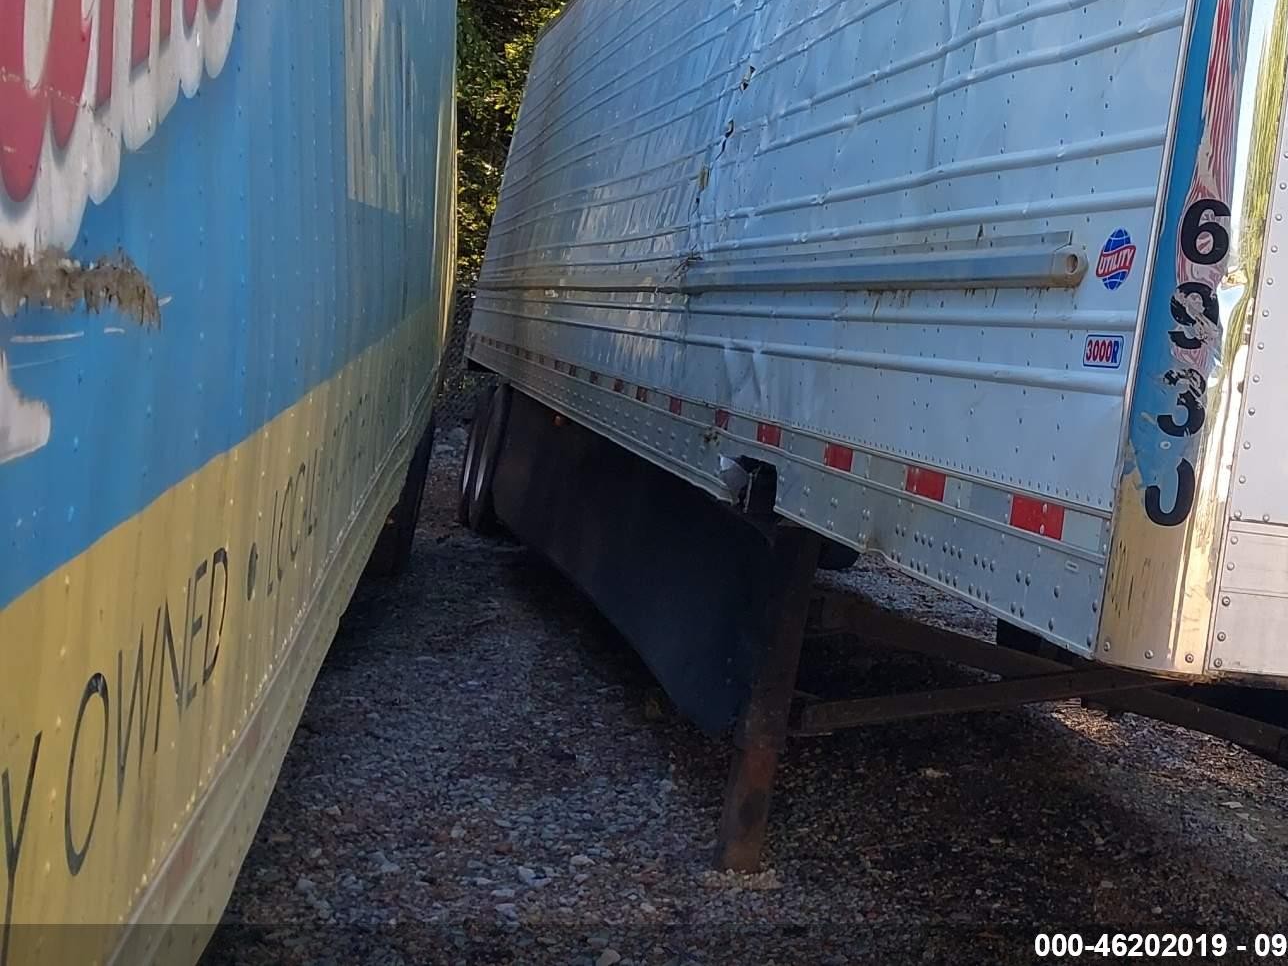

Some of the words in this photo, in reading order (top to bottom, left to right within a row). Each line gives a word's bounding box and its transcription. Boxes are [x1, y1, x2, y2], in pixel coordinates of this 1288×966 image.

[1098, 248, 1134, 274] UTILITY
[1085, 339, 1120, 364] 3000R
[64, 547, 229, 877] OWNED
